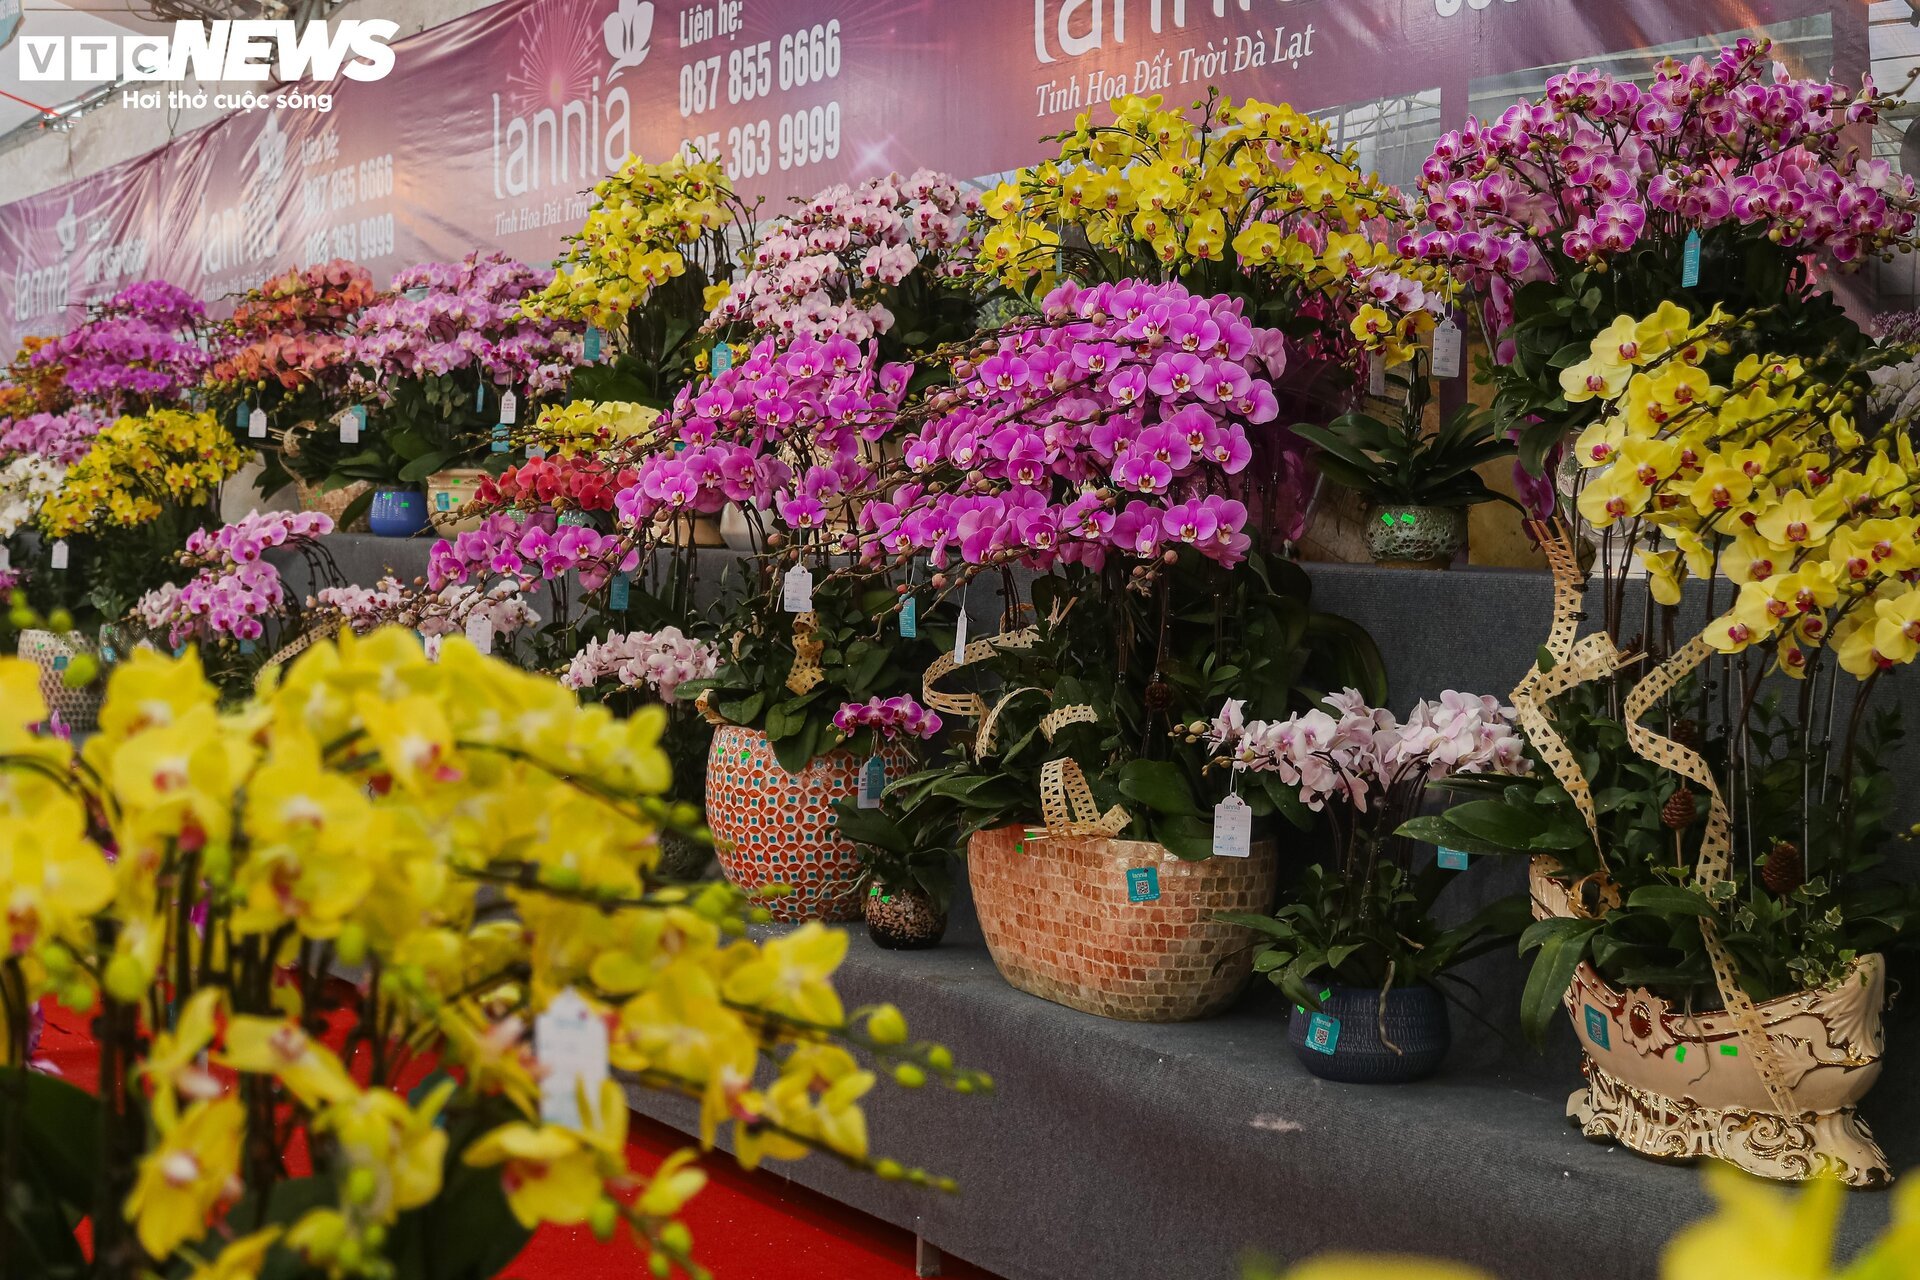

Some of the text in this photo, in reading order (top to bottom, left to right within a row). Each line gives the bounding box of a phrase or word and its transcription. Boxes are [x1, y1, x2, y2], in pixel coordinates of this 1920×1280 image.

[680, 4, 714, 48] Liên
[680, 19, 841, 118] 087 855 6666
[1036, 75, 1080, 117] Tinh
[1085, 70, 1127, 106] Hoa
[1133, 49, 1173, 95] Đất
[1179, 37, 1228, 84] Trời
[1233, 30, 1266, 73] Đà
[1272, 24, 1316, 70] Lạt
[727, 119, 771, 182] 363
[778, 101, 841, 171] 9999
[331, 165, 356, 210] 855
[359, 153, 393, 202] 6666
[360, 212, 394, 260] 9999
[520, 207, 541, 231] Hoa
